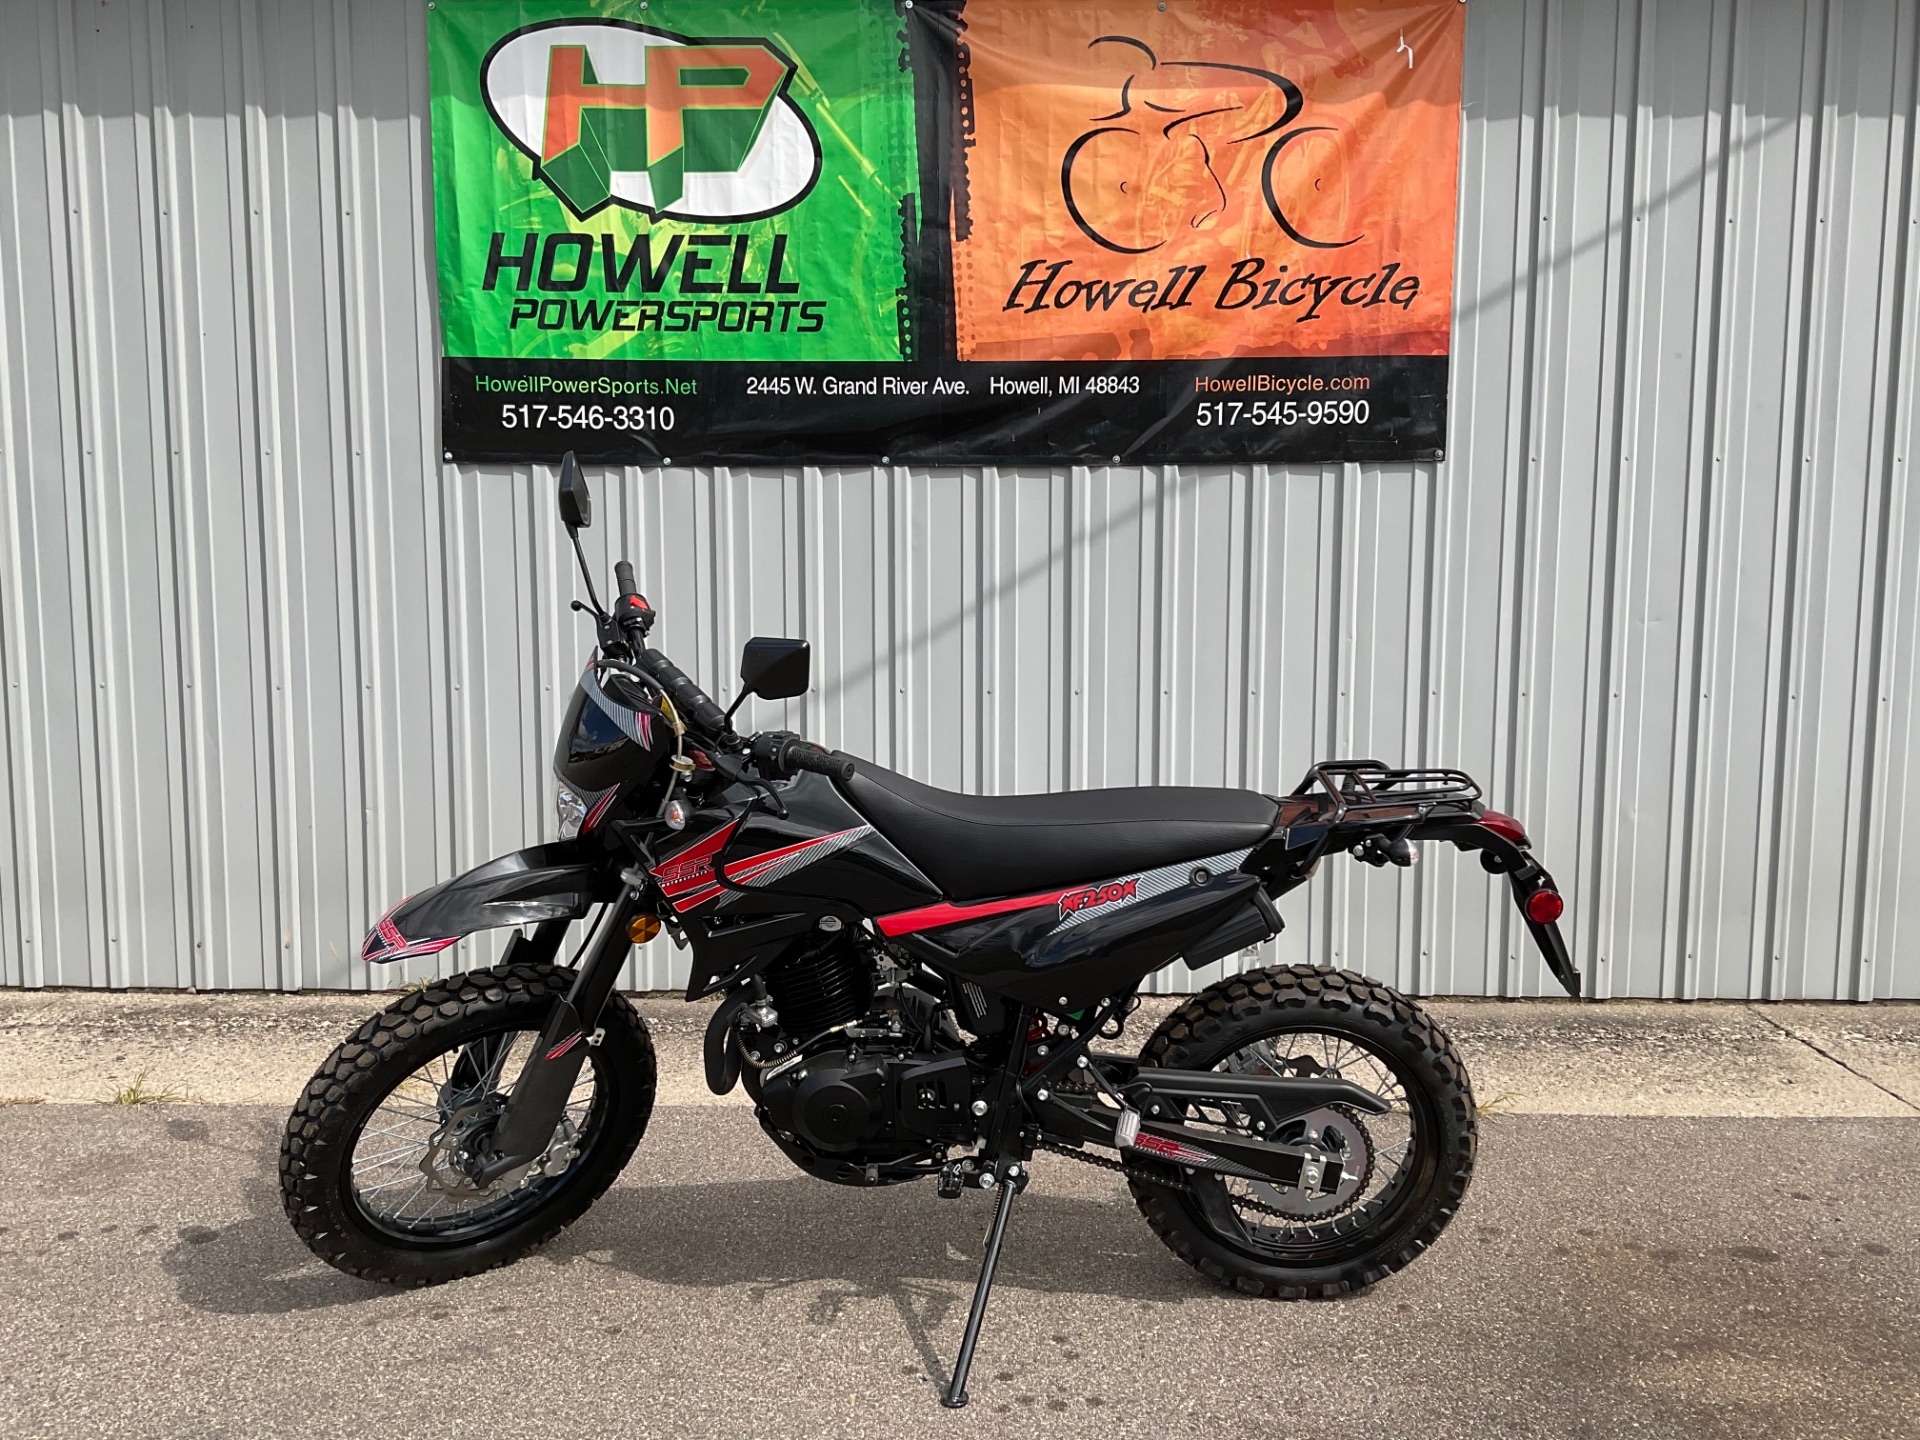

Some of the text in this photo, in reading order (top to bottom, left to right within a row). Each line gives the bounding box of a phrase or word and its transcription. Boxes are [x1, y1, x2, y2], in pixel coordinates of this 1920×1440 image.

[541, 45, 789, 206] HP
[482, 232, 800, 294] HOWELL
[1002, 257, 1420, 323] Howell Bicycle
[509, 298, 827, 333] POWERSPORTS
[475, 375, 697, 397] HowellPowerSports.Net
[746, 376, 1140, 397] 2445 W. Grand River Ave. Howell, MI 48843
[1195, 374, 1370, 394] HowellBicycle.com
[501, 404, 675, 431] 517-546-3310
[1196, 400, 1370, 427] 517-545-9590
[662, 854, 714, 883] SSR
[1061, 879, 1138, 914] XF250X
[377, 918, 409, 954] SSR
